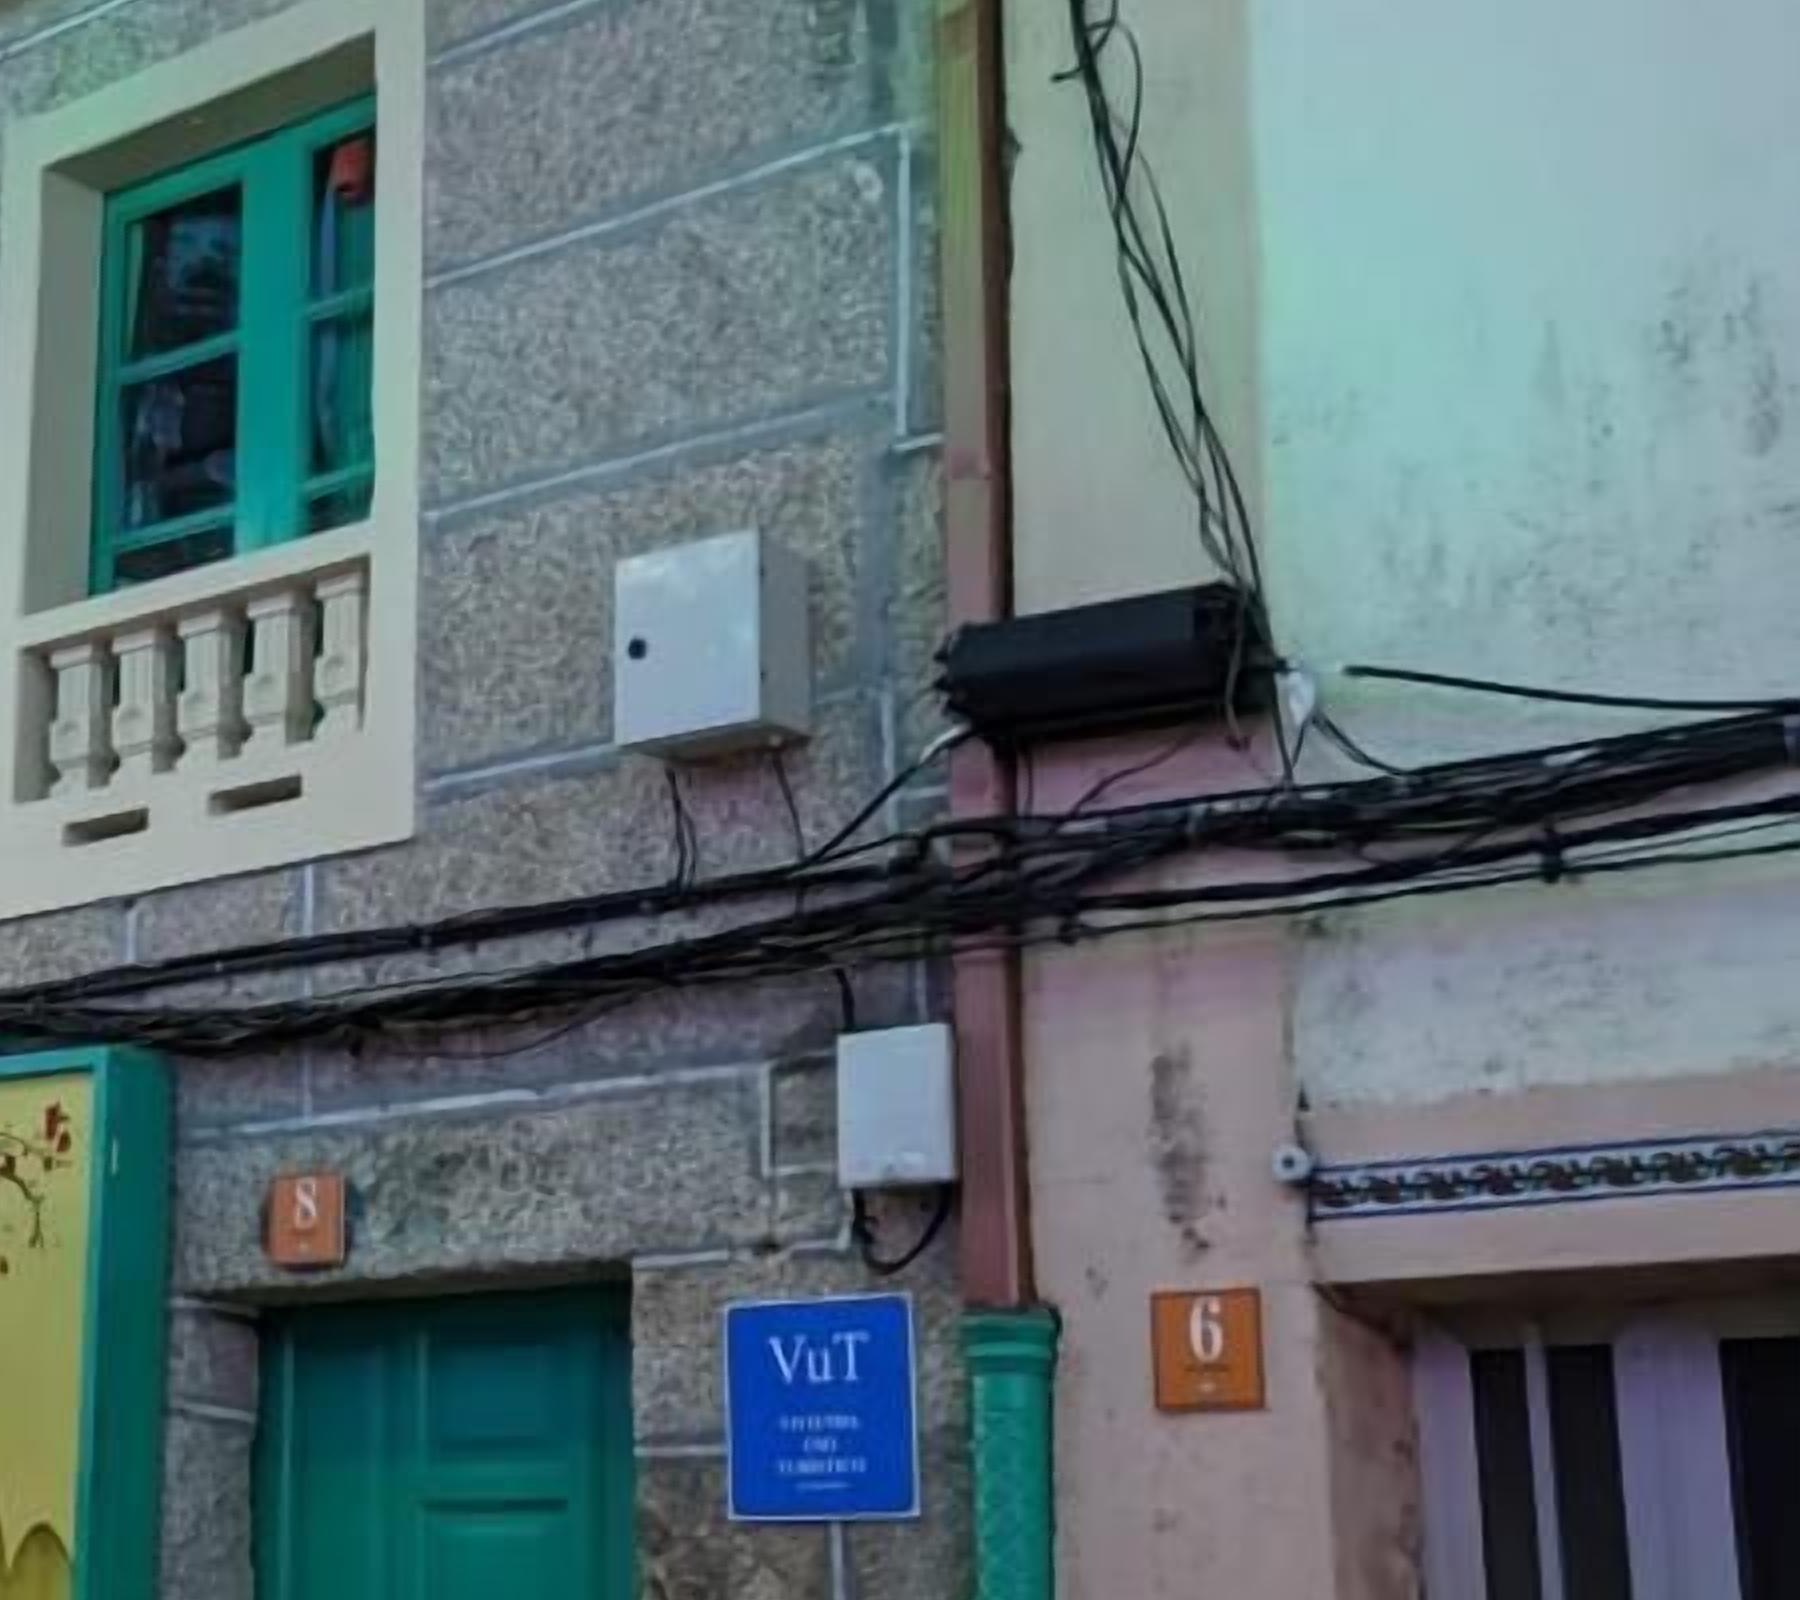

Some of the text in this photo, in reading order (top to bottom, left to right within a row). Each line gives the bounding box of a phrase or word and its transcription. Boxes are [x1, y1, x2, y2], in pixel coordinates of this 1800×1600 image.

[294, 1176, 317, 1229] 8
[768, 1329, 871, 1385] VuT
[1190, 1296, 1223, 1362] 6
